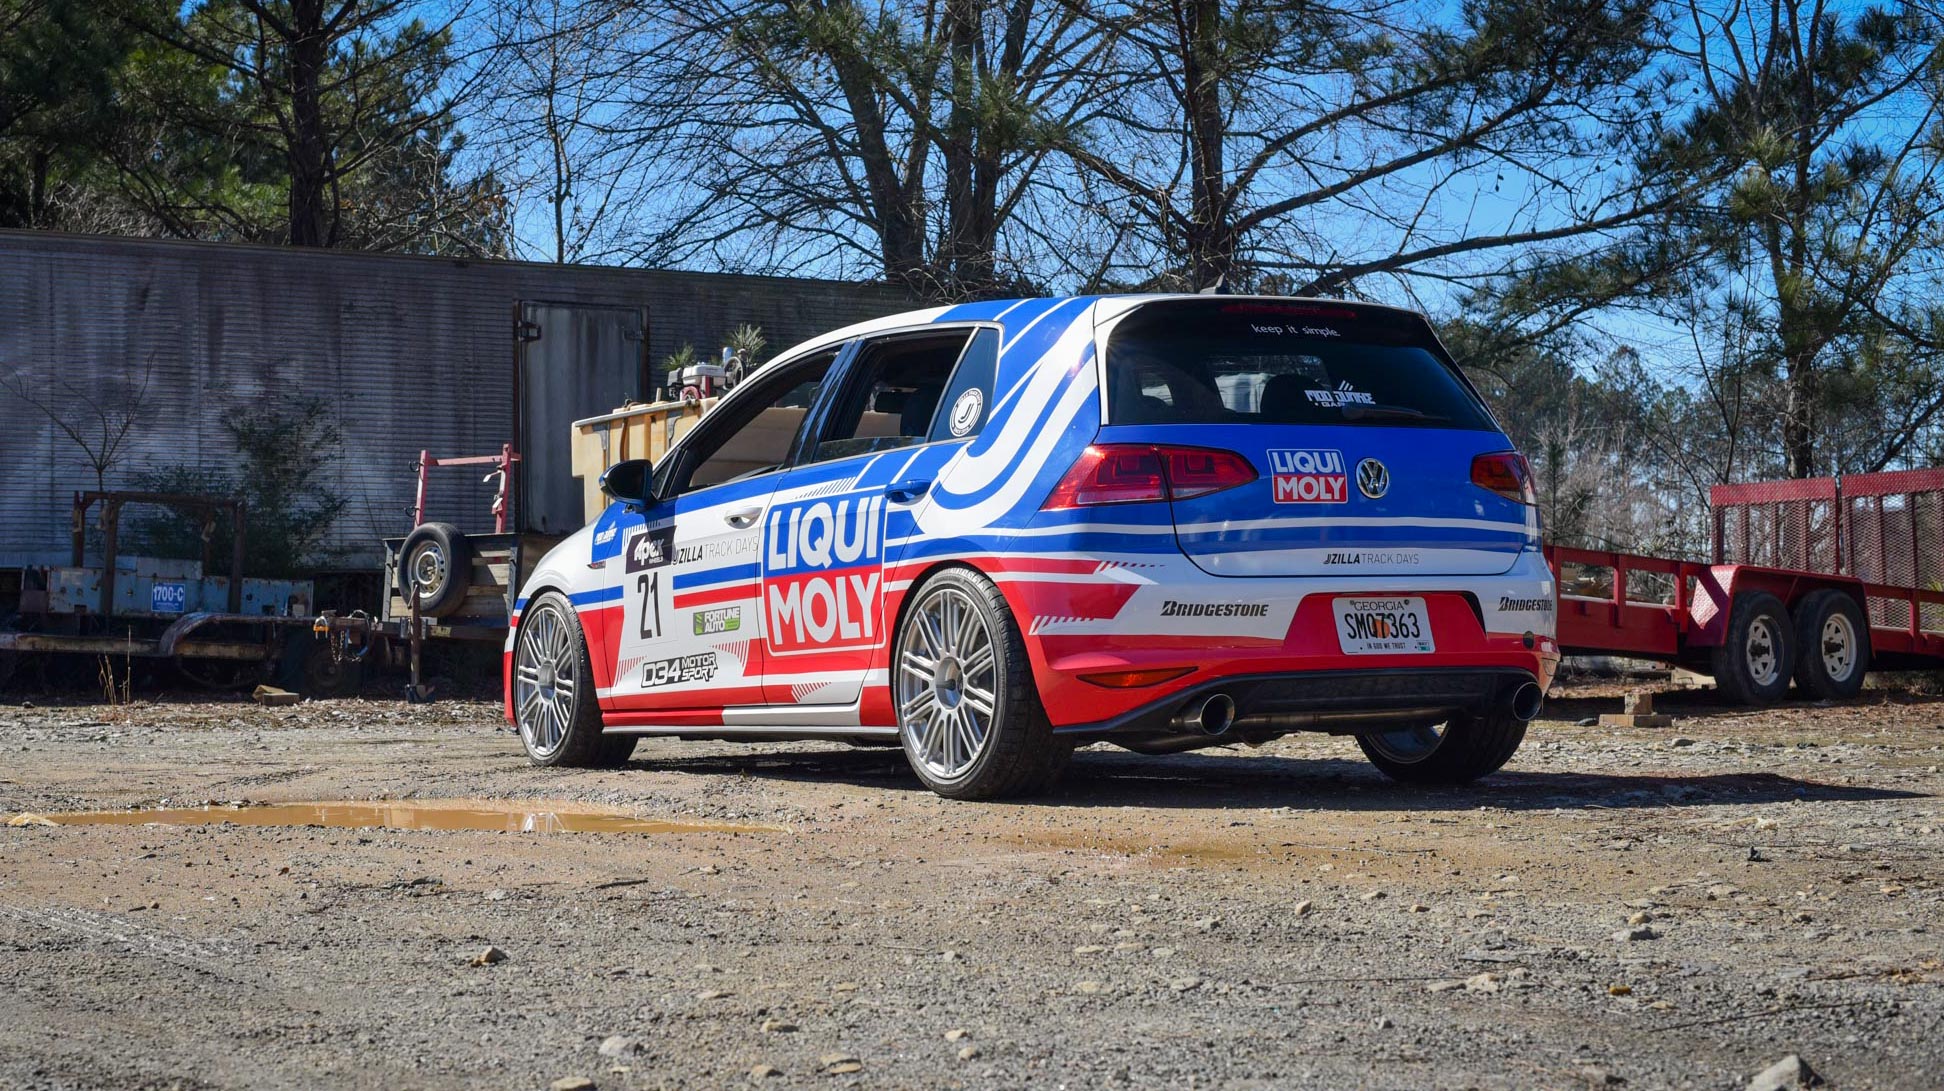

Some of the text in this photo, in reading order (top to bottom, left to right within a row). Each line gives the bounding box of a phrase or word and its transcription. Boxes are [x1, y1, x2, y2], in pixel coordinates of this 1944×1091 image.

[1250, 323, 1283, 336] keep
[1286, 325, 1299, 334] it
[1272, 451, 1342, 474] LIQUI
[1277, 476, 1345, 501] MOLY
[768, 495, 884, 571] LIQUI
[704, 541, 733, 560] TRACK
[735, 535, 759, 555] DAYS
[1362, 553, 1394, 565] TRACK
[1396, 554, 1420, 565] DAYS
[153, 586, 184, 602] 1700-C
[637, 571, 662, 640] 21
[768, 572, 881, 646] MOLY
[1353, 601, 1405, 611] GEORGIA
[704, 607, 740, 622] FORTUNE
[704, 620, 725, 633] AUTO
[680, 653, 716, 669] MOTOR
[681, 664, 718, 681] SPORT
